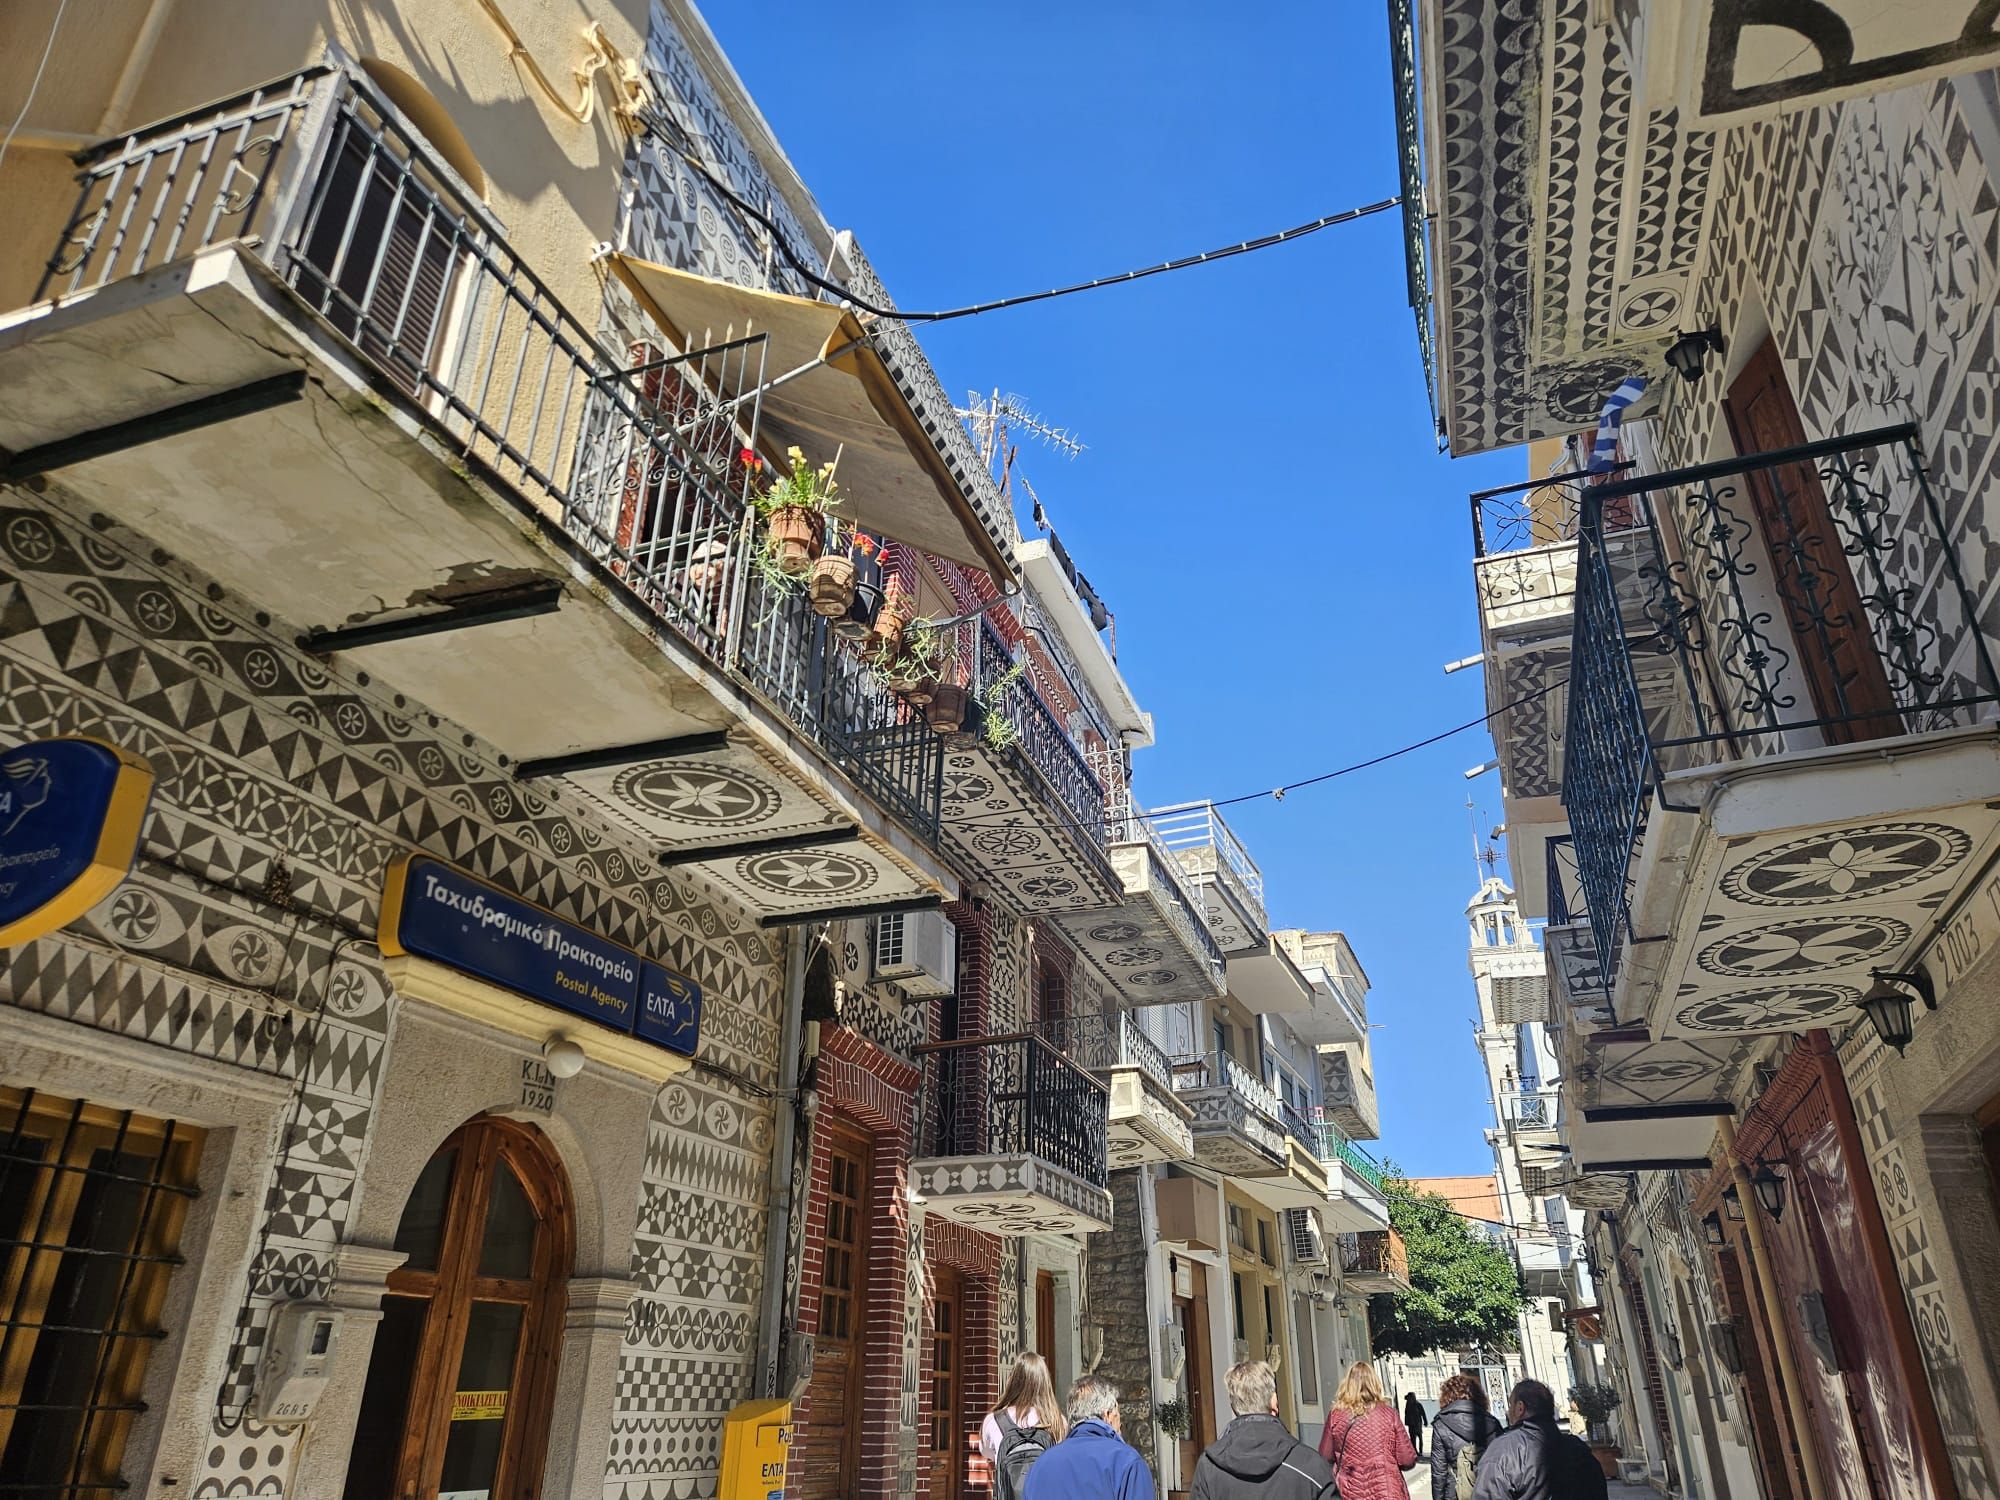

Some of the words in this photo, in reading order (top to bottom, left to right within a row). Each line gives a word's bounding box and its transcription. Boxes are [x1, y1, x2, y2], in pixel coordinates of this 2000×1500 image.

[426, 875, 543, 944] Ταχυδρομικό
[547, 928, 633, 983] Πρακτορείο
[1936, 912, 1980, 988] 2003
[555, 970, 589, 995] Postal
[591, 985, 628, 1014] Agency
[647, 992, 675, 1020] ΕΛΤΑ
[521, 1088, 553, 1111] 1920
[455, 1393, 507, 1408] ΝΟΙΚΙΑΖΕΤΑΙ
